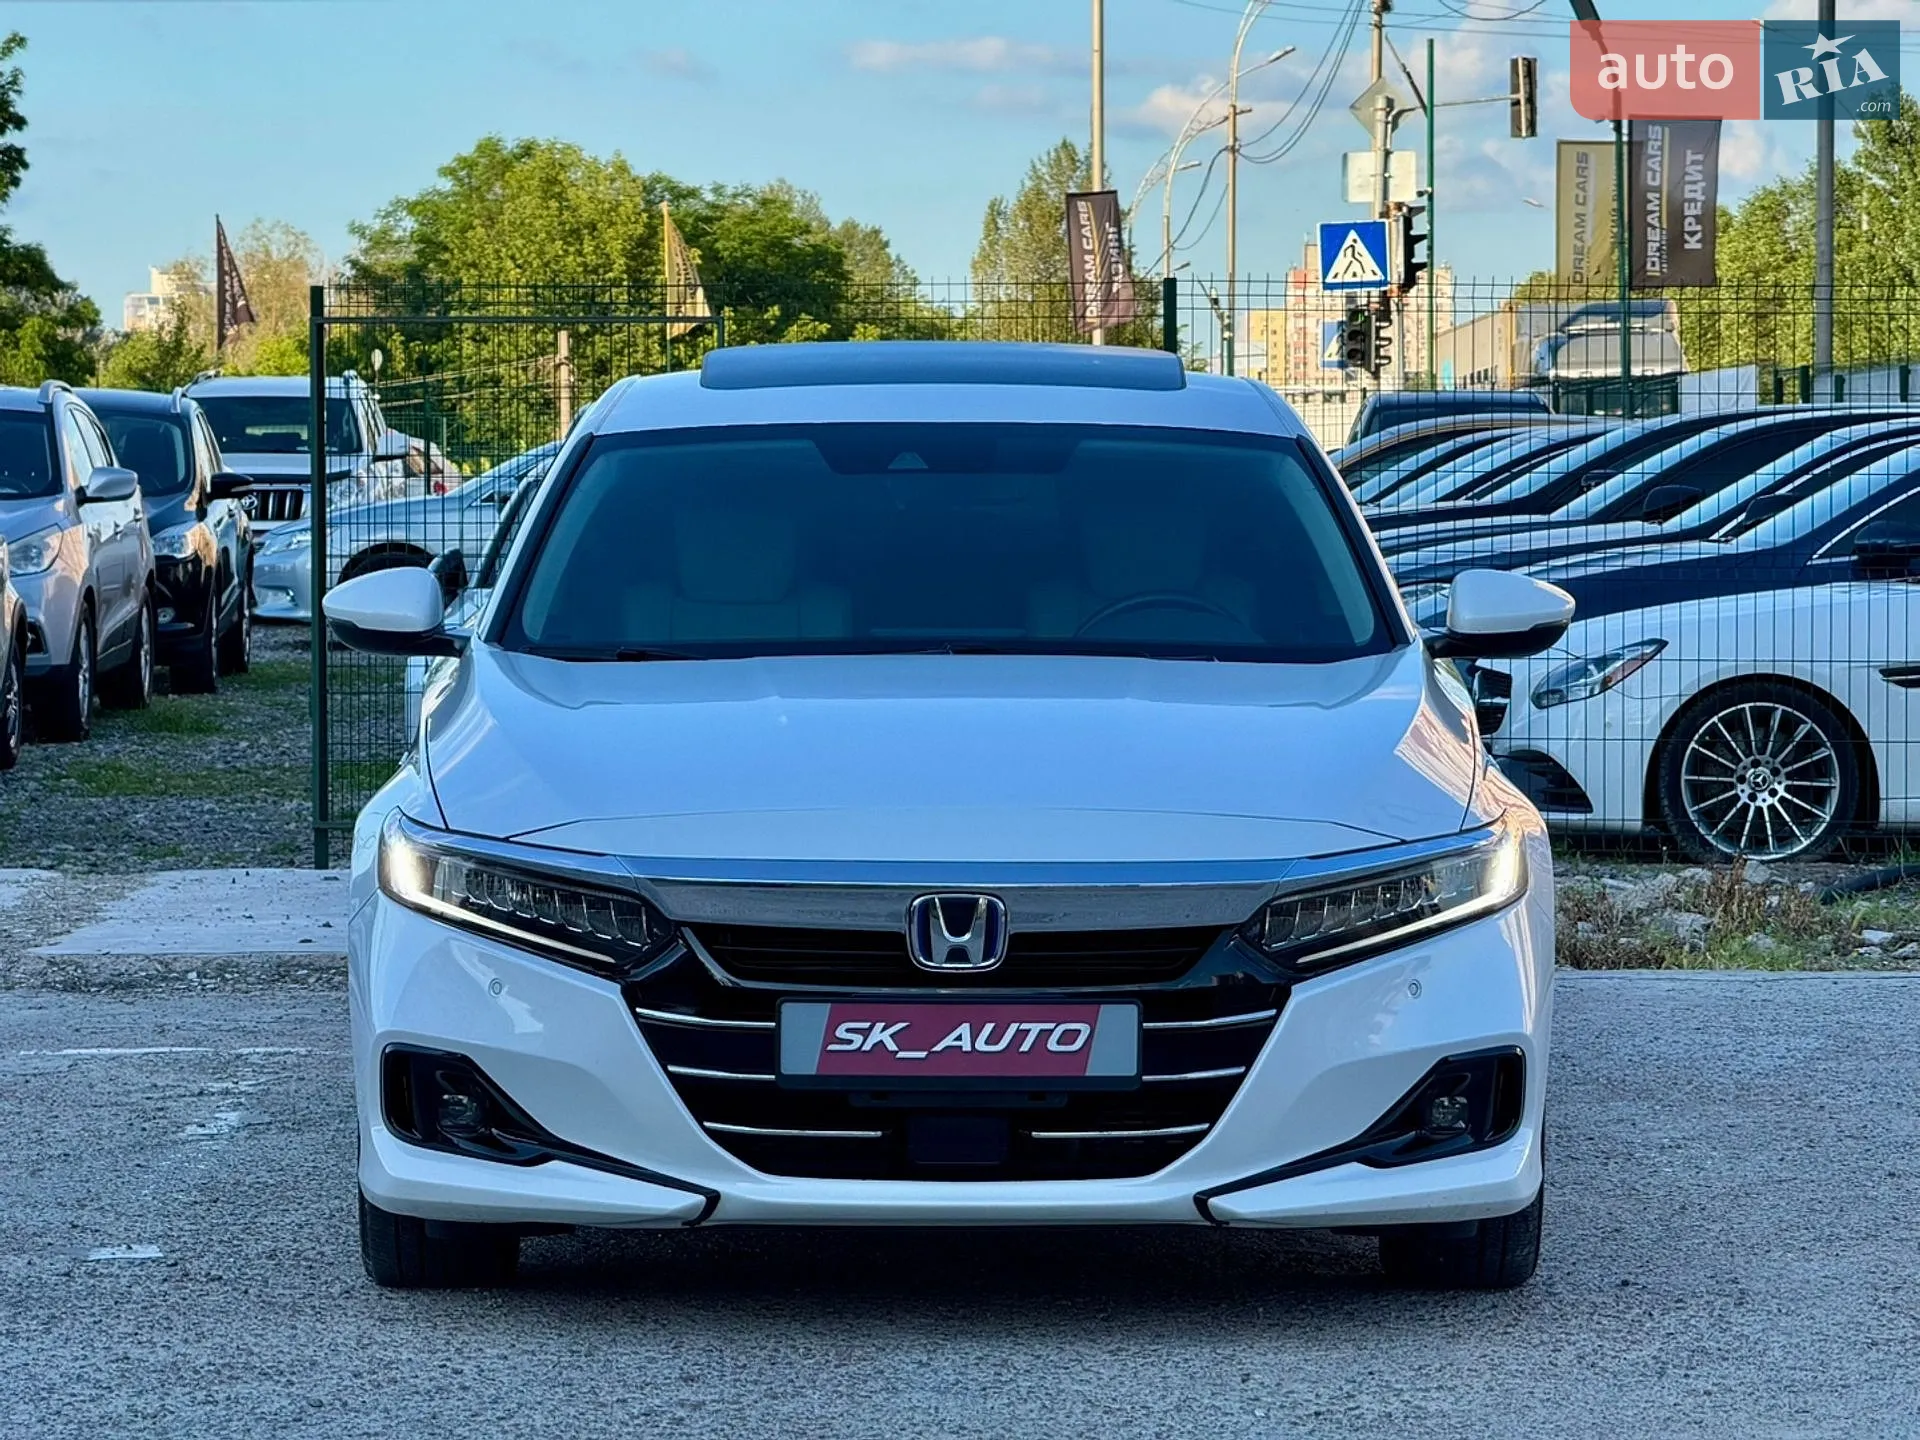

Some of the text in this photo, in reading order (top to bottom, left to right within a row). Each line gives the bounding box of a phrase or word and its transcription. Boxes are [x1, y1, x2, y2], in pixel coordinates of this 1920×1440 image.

[1572, 152, 1589, 284] DREAM CARS
[1645, 124, 1662, 271] DREAM CARS
[1683, 149, 1706, 249] КРЕДИТ
[1084, 254, 1097, 317] DREAM
[826, 1022, 1091, 1058] SK_AUTO
